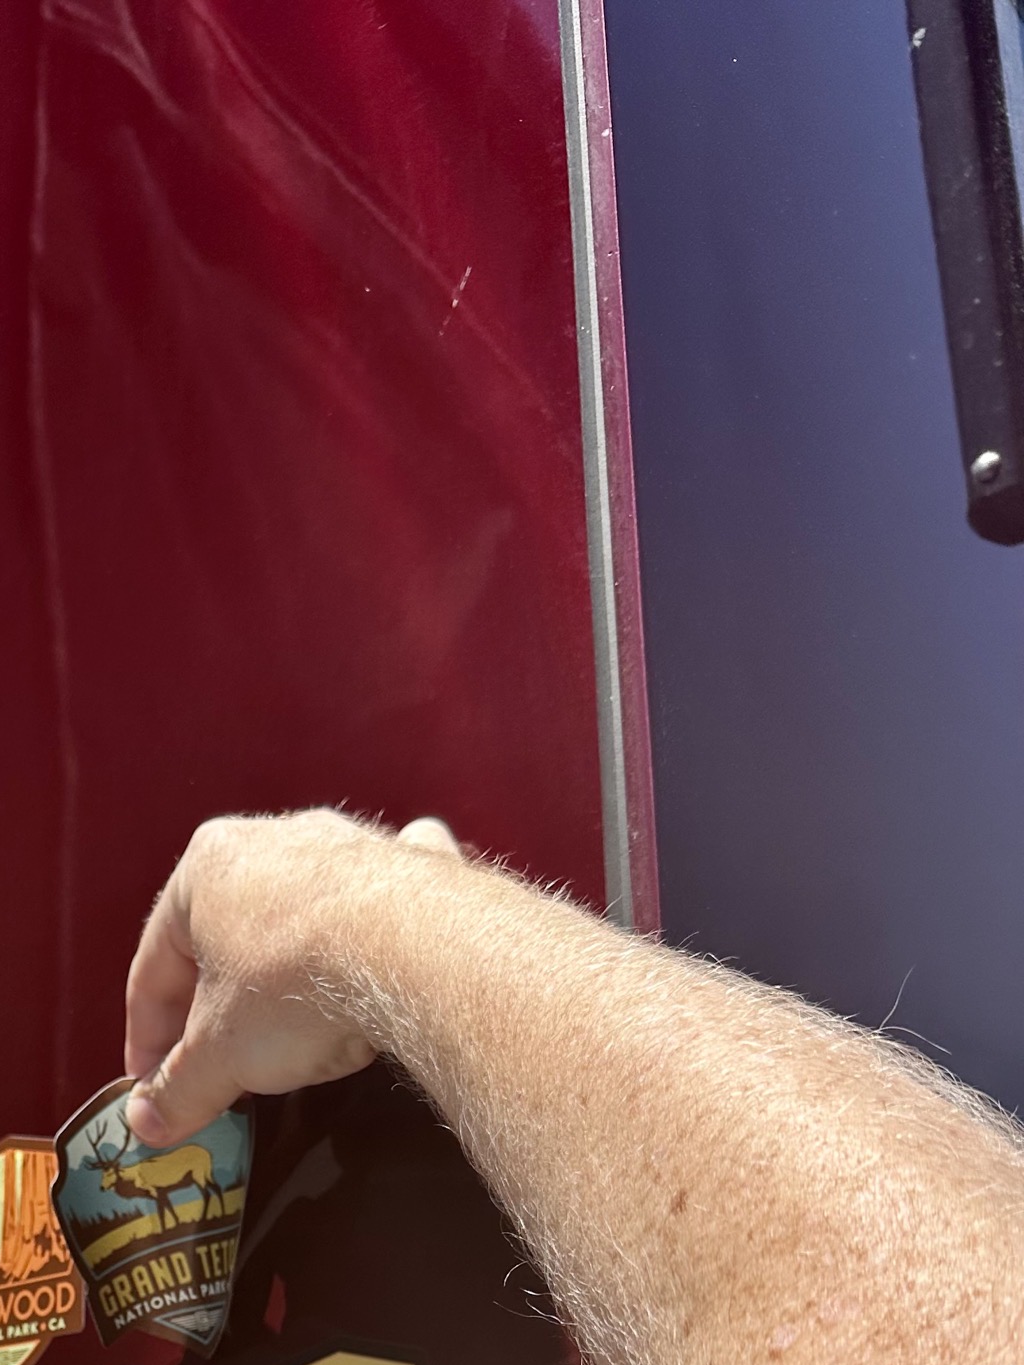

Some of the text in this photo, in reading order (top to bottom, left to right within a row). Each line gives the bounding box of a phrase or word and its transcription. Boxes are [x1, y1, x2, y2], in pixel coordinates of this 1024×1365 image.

[99, 1238, 236, 1317] GRAND TET
[6, 1321, 39, 1338] PARK
[47, 1317, 66, 1331] CA
[114, 1280, 227, 1329] NATIONAL PARK
